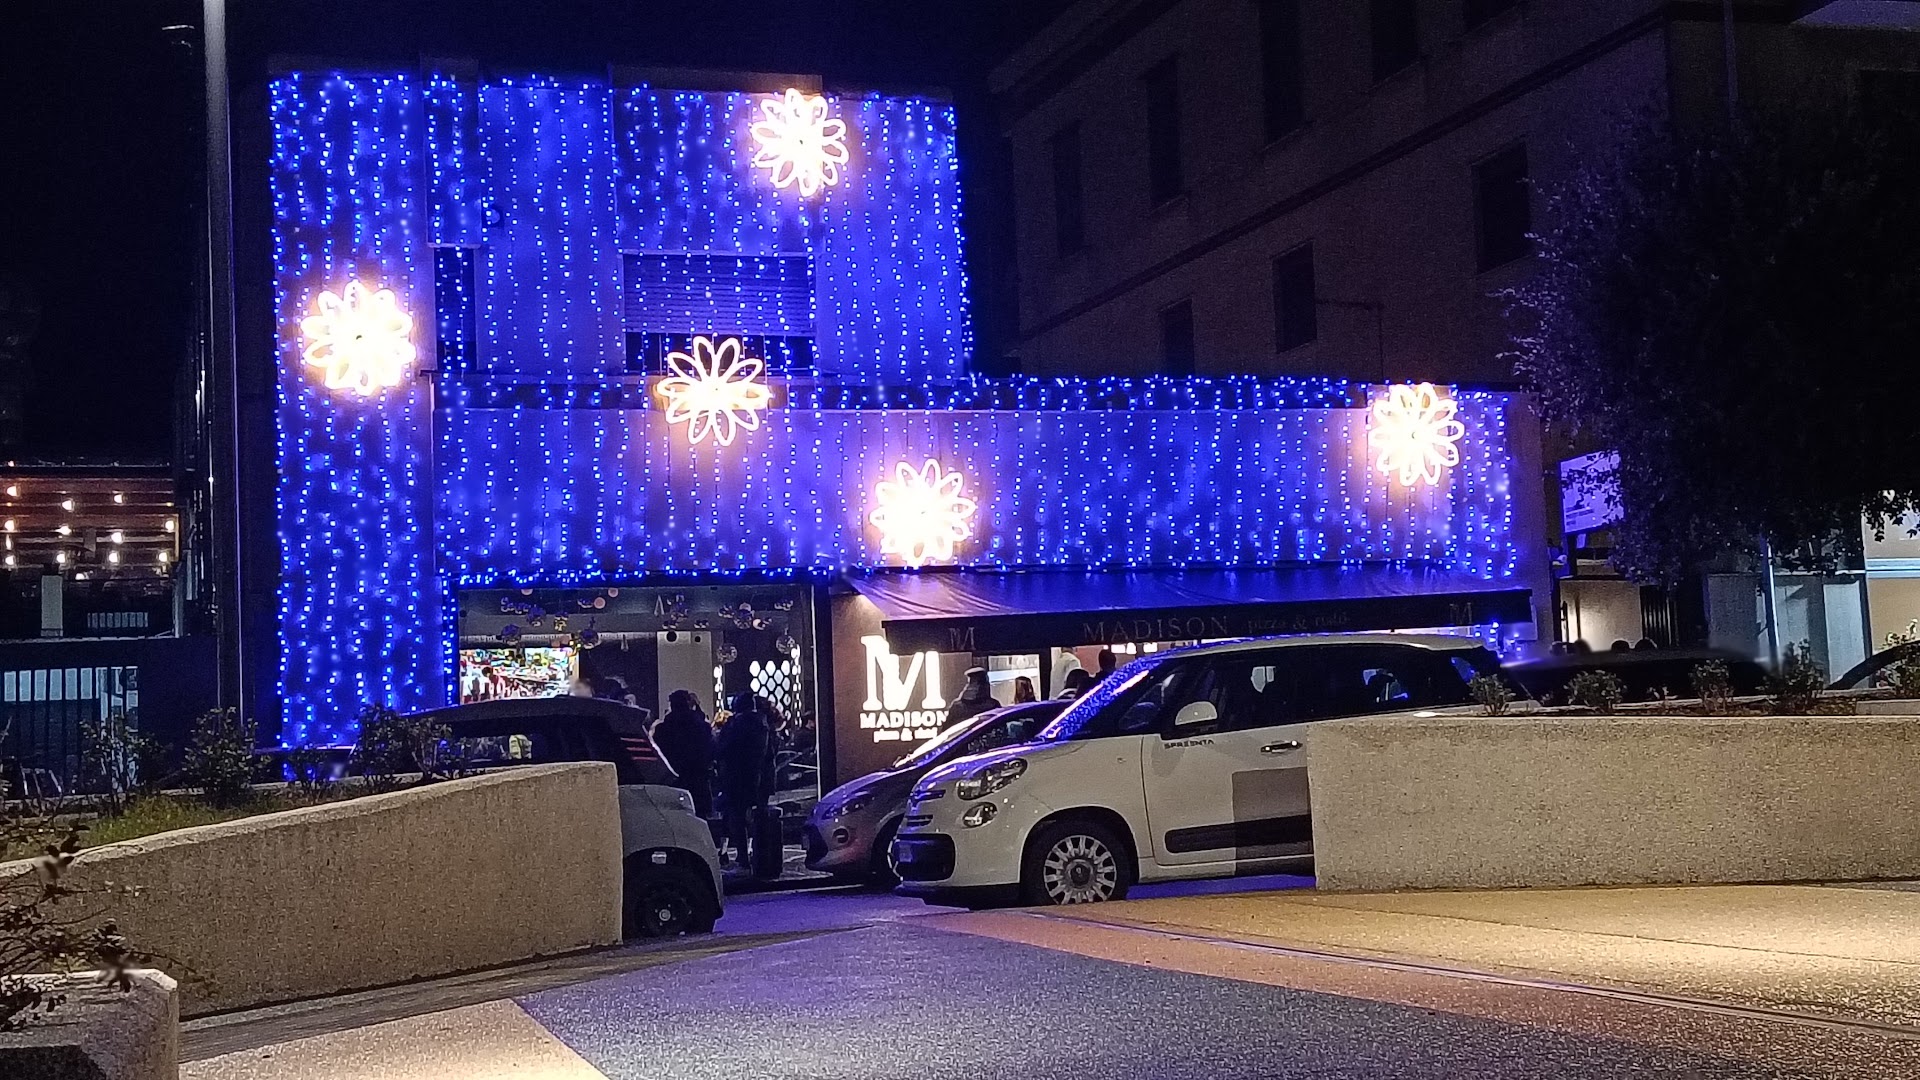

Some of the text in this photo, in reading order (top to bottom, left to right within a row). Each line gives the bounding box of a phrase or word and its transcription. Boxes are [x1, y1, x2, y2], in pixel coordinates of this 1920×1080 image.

[948, 626, 976, 651] M
[1082, 615, 1229, 643] MADISON
[861, 635, 946, 711] M
[860, 710, 949, 729] MADISON
